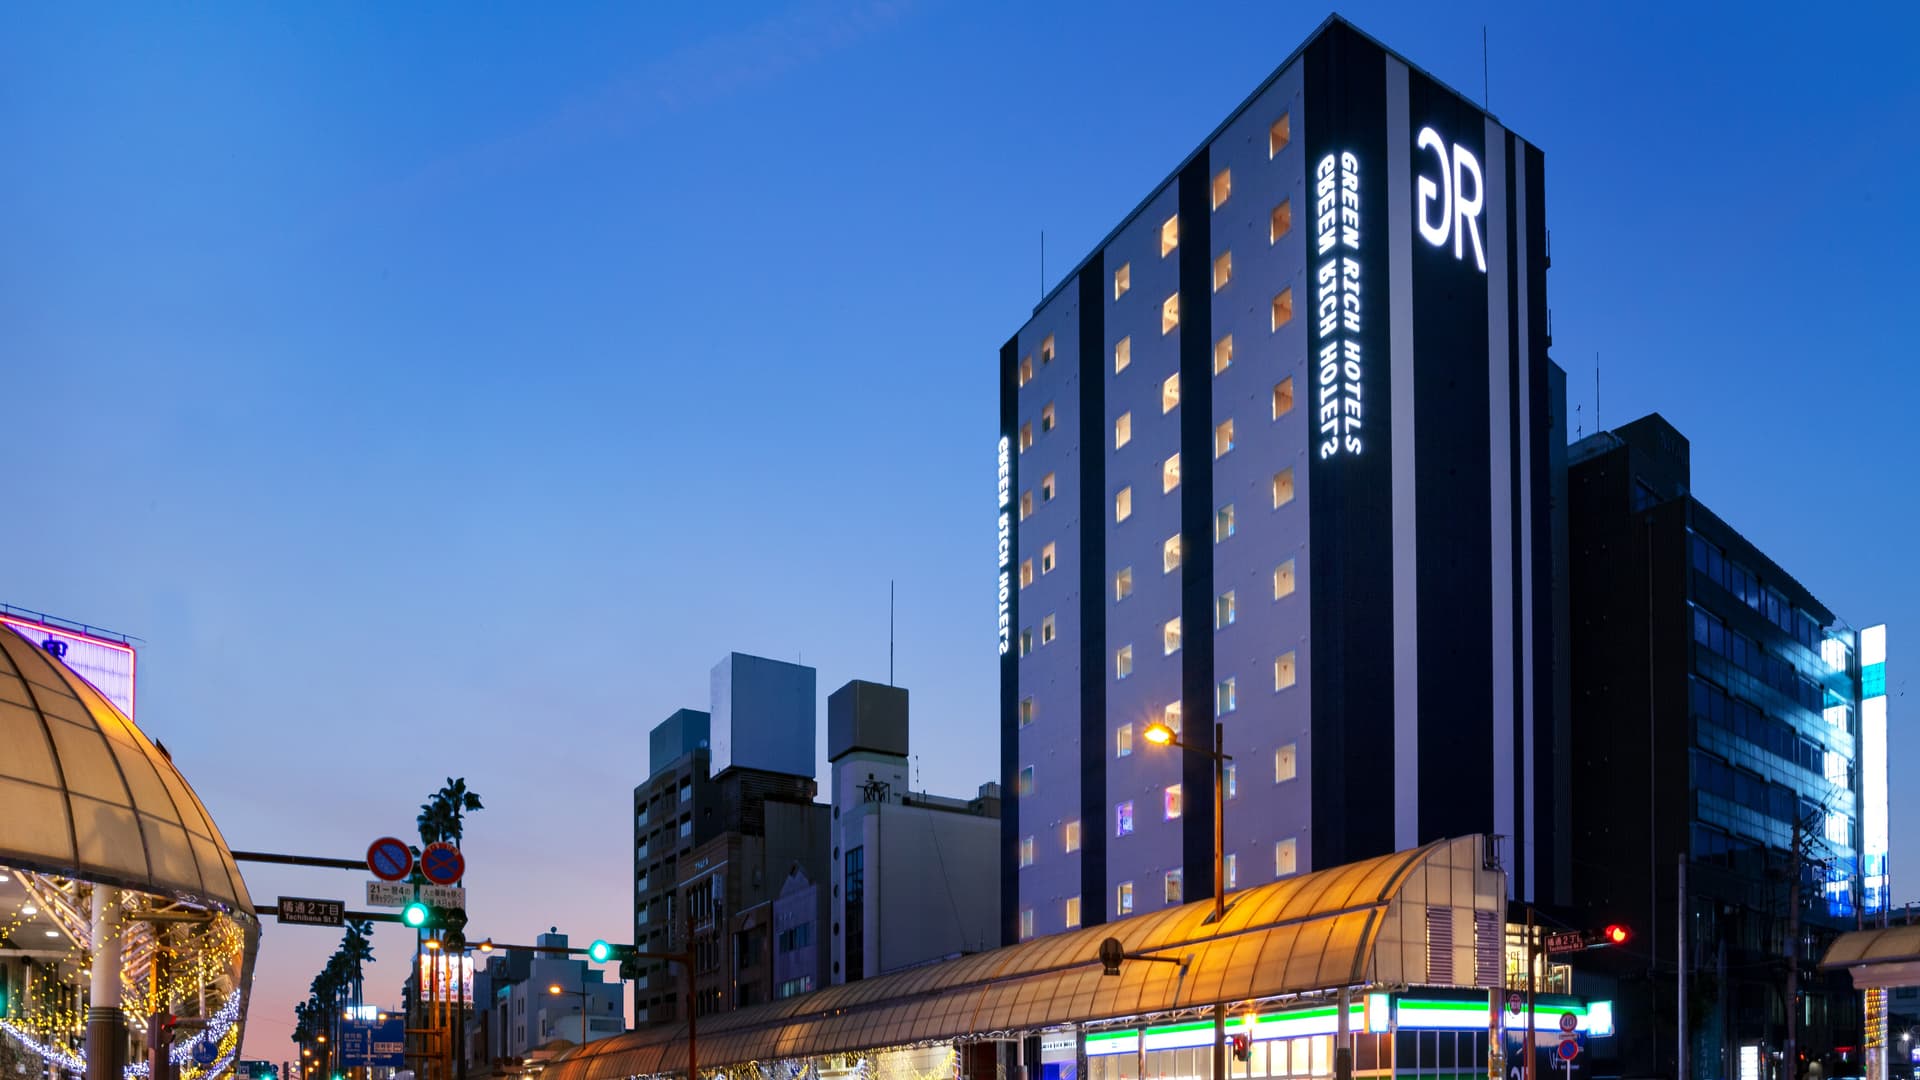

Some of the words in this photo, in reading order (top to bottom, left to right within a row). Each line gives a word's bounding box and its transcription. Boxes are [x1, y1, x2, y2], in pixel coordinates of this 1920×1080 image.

[1341, 151, 1360, 250] GREEN
[1342, 257, 1361, 334] RICH
[1344, 340, 1362, 455] HOTELS
